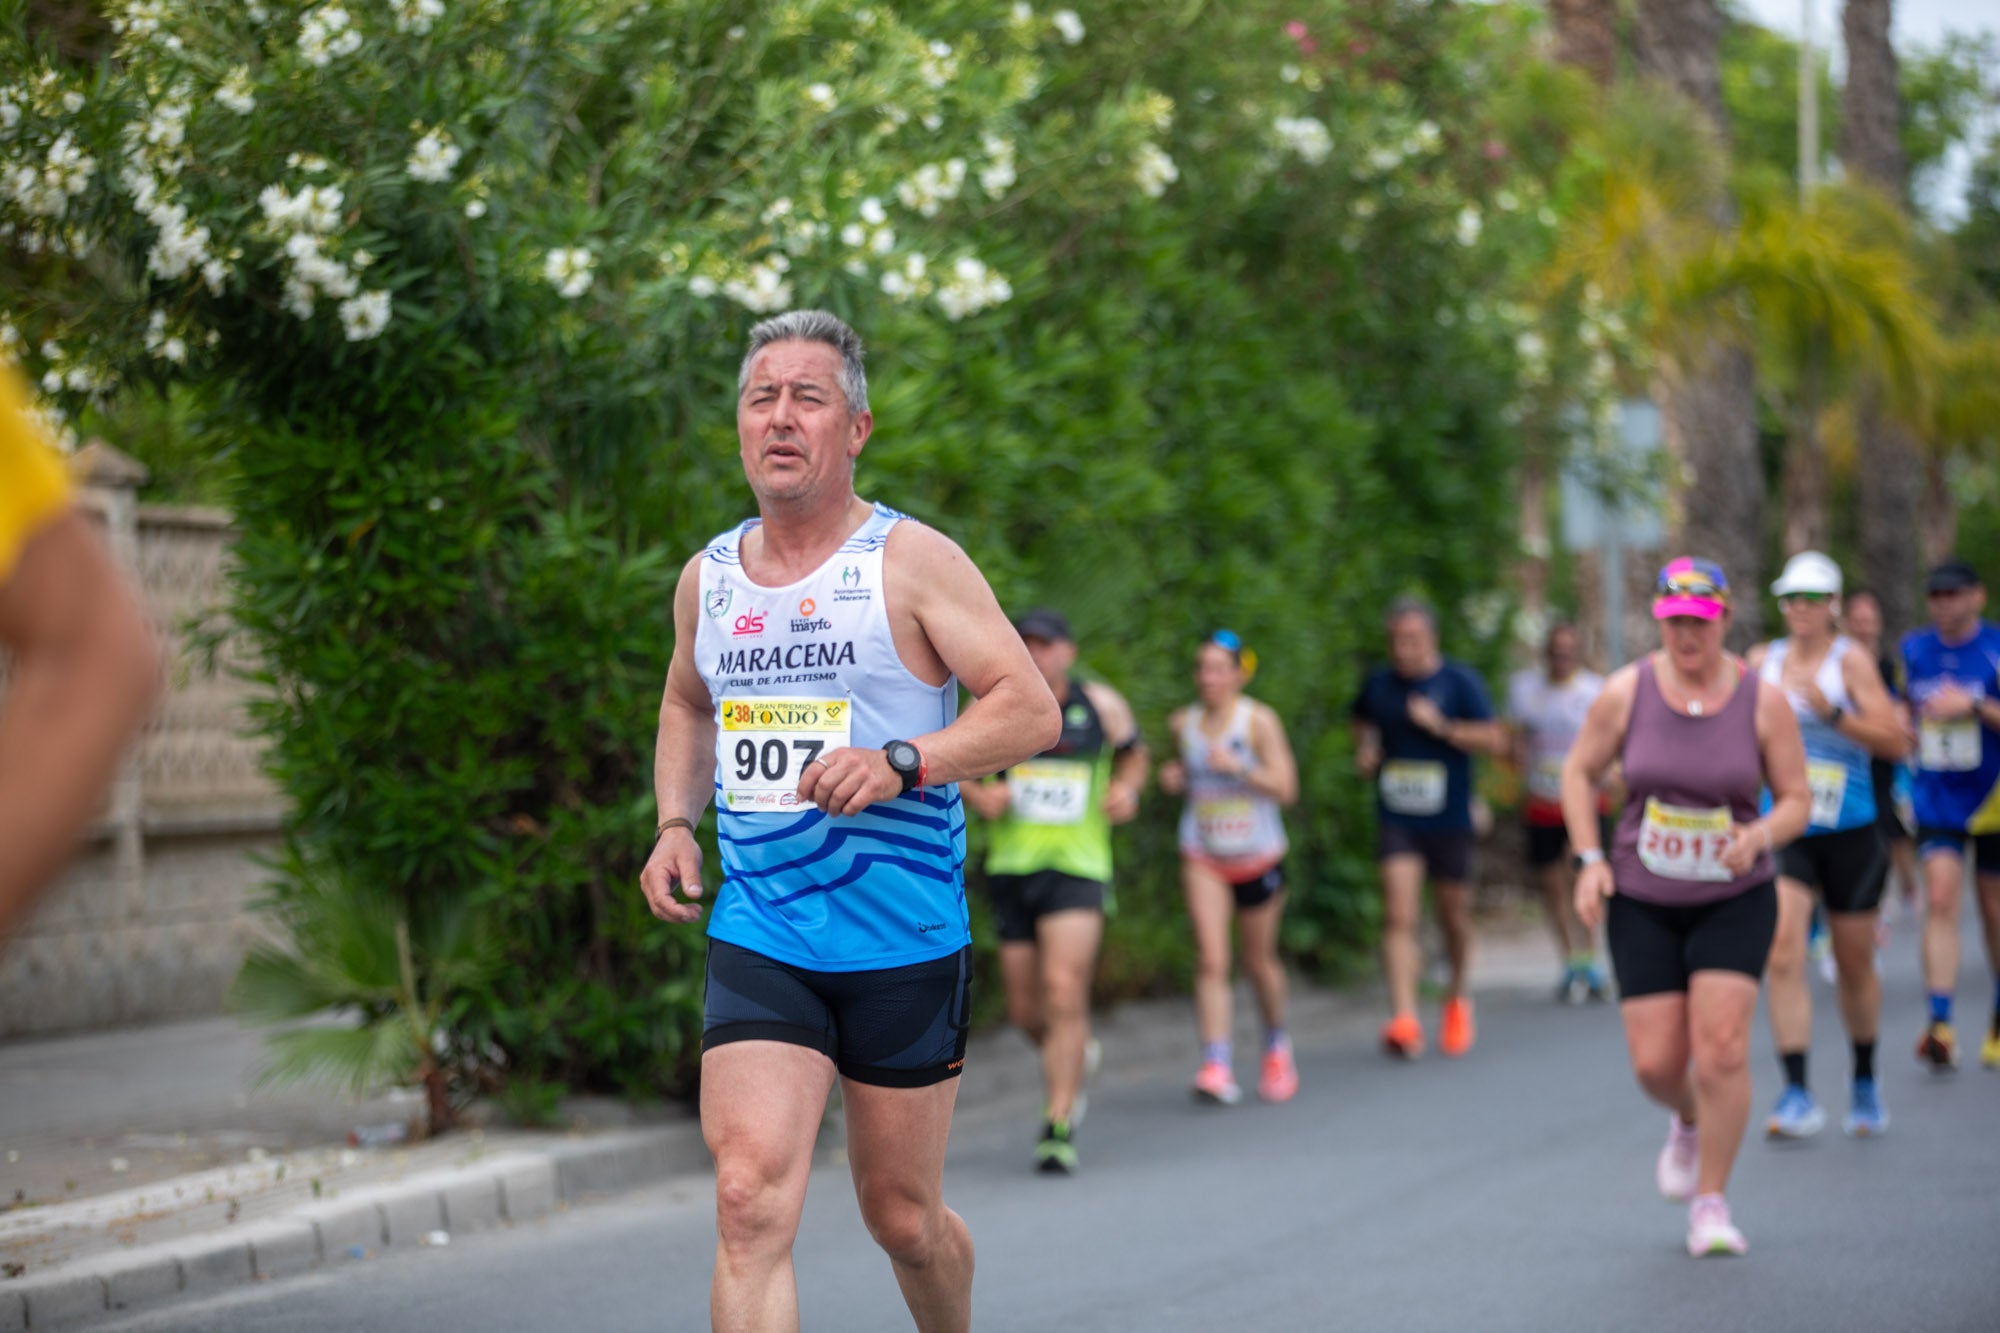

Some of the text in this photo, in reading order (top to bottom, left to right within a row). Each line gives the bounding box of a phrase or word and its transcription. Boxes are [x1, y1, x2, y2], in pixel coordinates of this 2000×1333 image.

[715, 640, 857, 676] MARACENA
[730, 671, 837, 687] CLUB DE ATLETISMO
[734, 704, 751, 723] 38
[777, 703, 812, 711] PREMIO
[750, 710, 818, 725] FONDO
[735, 738, 825, 781] 907
